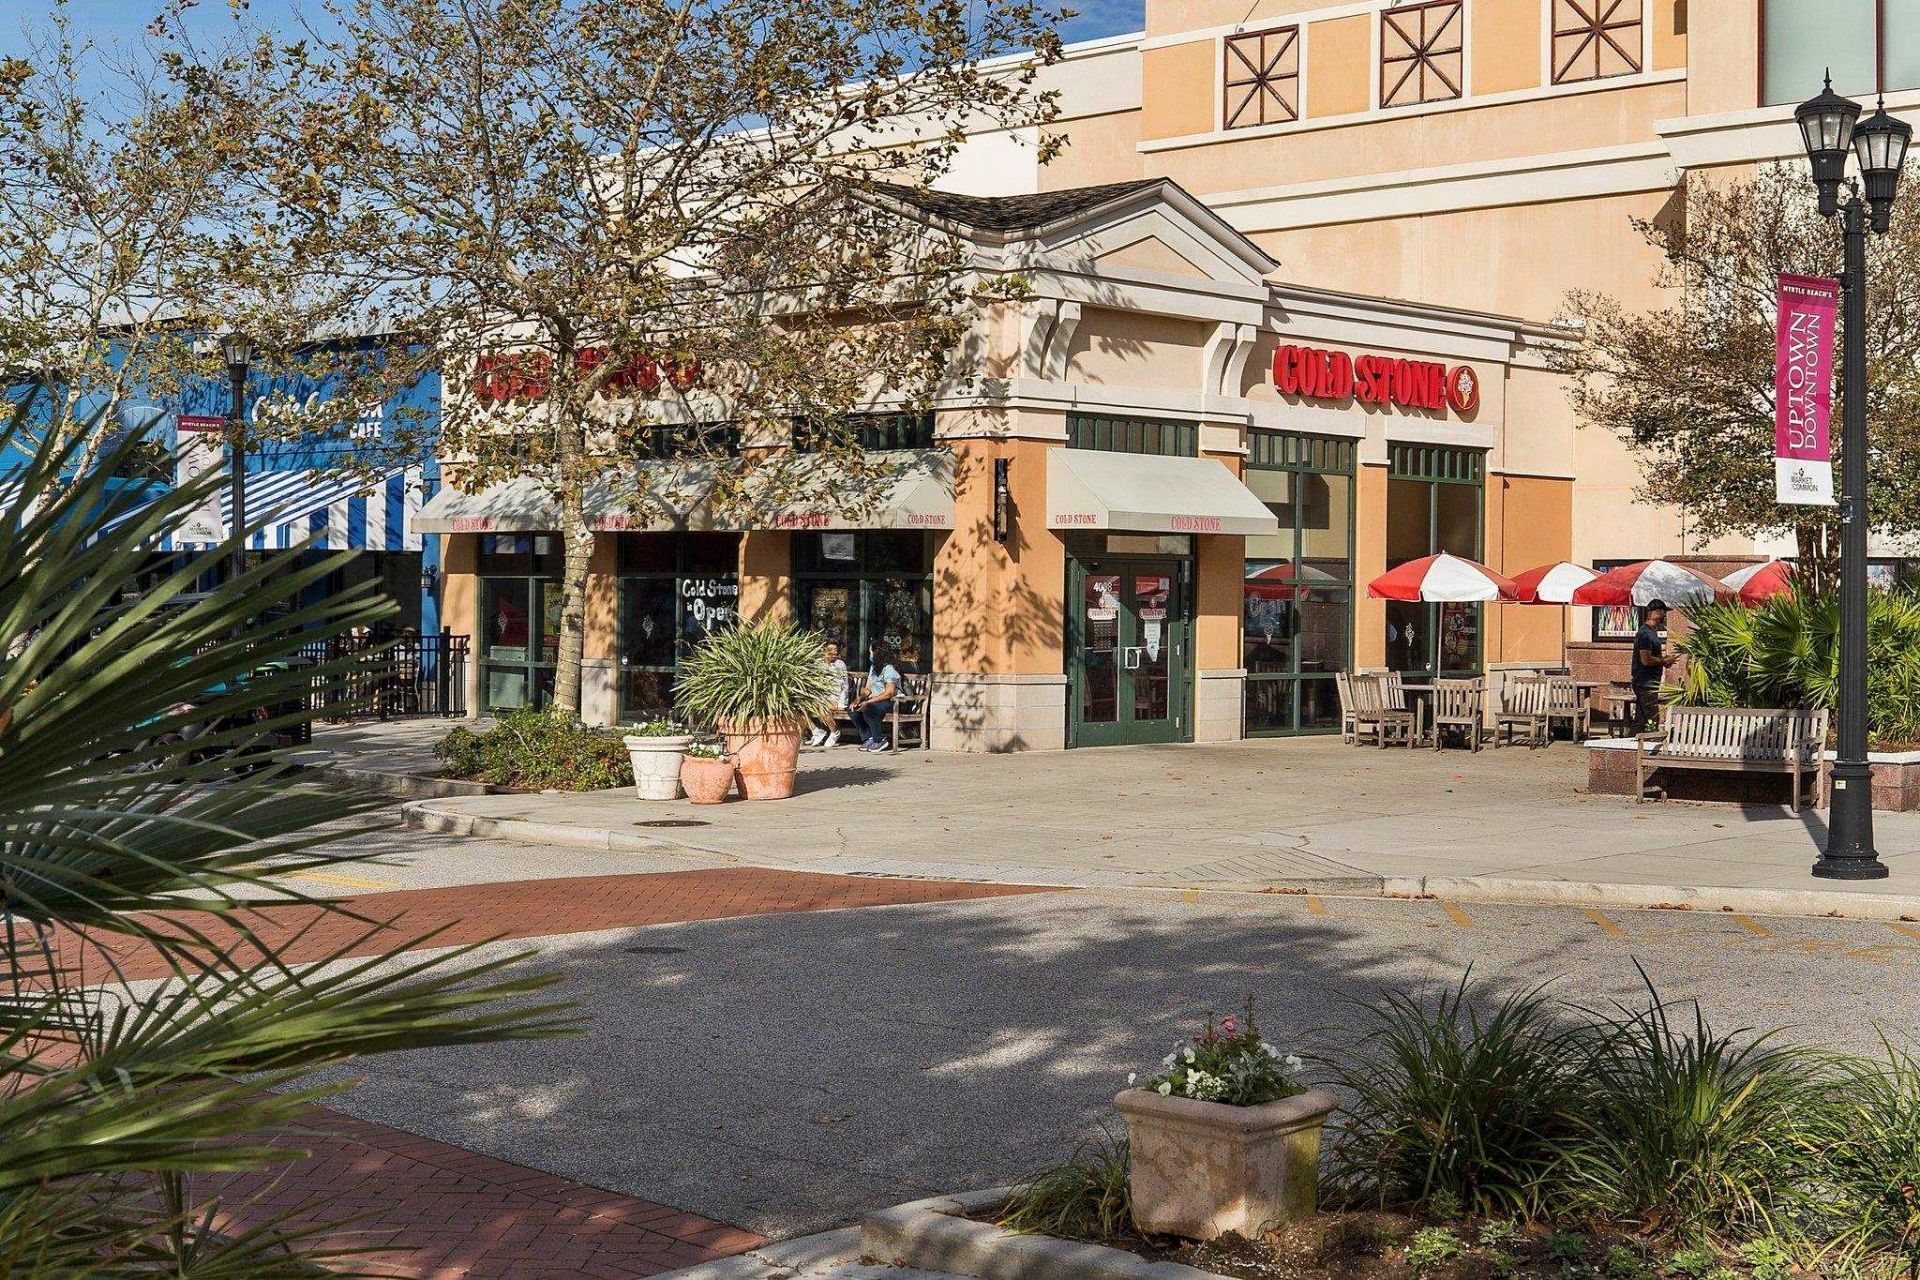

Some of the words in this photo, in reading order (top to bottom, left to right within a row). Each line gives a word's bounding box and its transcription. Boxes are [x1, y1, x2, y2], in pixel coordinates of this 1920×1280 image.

[1782, 285, 1805, 295] MYRTLE
[1806, 289, 1833, 298] BEACH'S
[1273, 345, 1354, 399] COLD
[1354, 354, 1448, 410] STONE
[1788, 310, 1807, 449] UPTOWN
[1804, 312, 1821, 450] DOWNTOWN
[349, 421, 382, 439] CAFE
[775, 513, 798, 528] COLD
[800, 511, 830, 527] STONE
[907, 514, 925, 525] COLD
[925, 514, 946, 525] STONE
[1055, 514, 1073, 525] COLD
[1073, 514, 1097, 525] STONE
[1170, 516, 1192, 530] COLD
[1193, 516, 1222, 532] STONE
[682, 578, 706, 597] Cold
[706, 579, 738, 597] Stone
